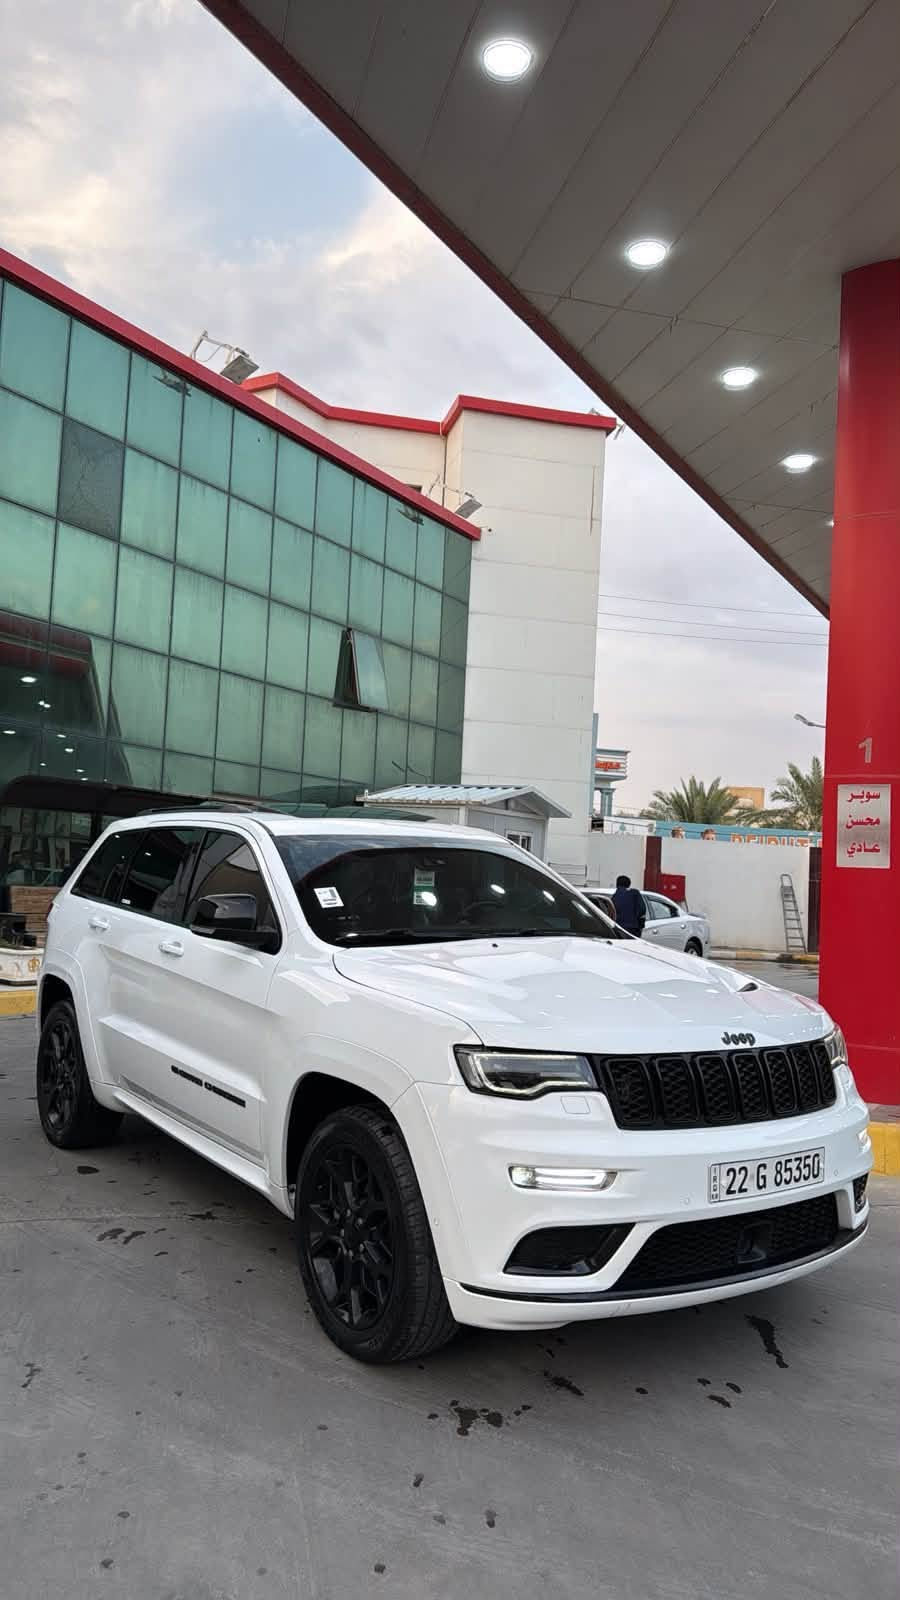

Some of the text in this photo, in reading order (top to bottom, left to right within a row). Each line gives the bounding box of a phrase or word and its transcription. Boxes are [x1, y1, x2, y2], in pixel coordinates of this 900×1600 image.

[858, 737, 873, 764] 1
[845, 814, 881, 830] محسن
[846, 840, 881, 858] عادي
[721, 1031, 756, 1047] Jeep
[725, 1152, 821, 1196] 22 G 85350
